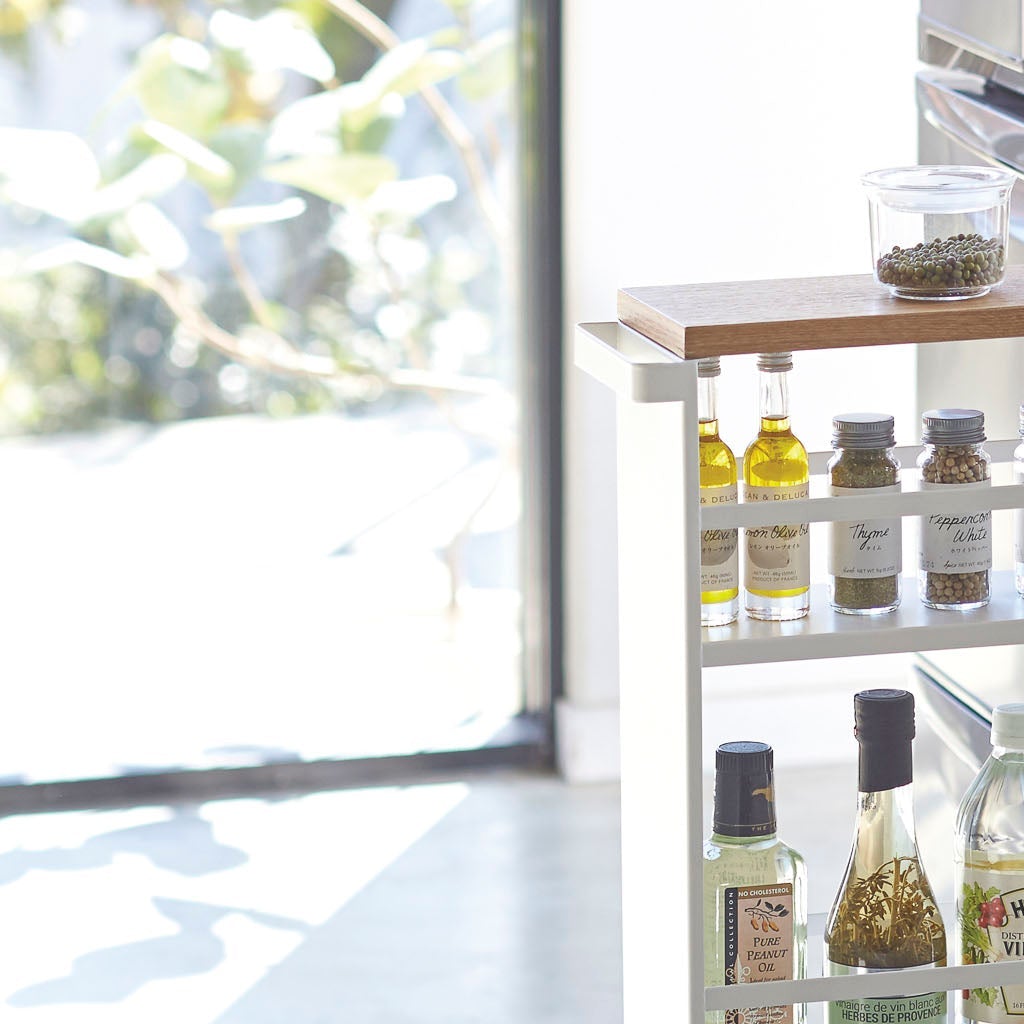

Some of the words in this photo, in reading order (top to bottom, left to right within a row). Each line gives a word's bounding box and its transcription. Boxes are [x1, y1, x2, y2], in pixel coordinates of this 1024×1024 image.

[770, 525, 798, 539] Olive
[849, 523, 890, 551] Thyme
[953, 526, 988, 543] White
[750, 888, 790, 896] CHOLESTEROL
[753, 937, 781, 947] PURE
[747, 949, 788, 960] PEANUT
[758, 962, 775, 972] OIL
[835, 999, 871, 1012] vinaigre
[873, 1002, 887, 1012] de
[890, 1002, 906, 1012] vin
[909, 998, 934, 1010] blanc
[841, 1009, 879, 1023] HERBES
[881, 1013, 895, 1023] DE
[897, 1005, 941, 1022] PROVENCE
